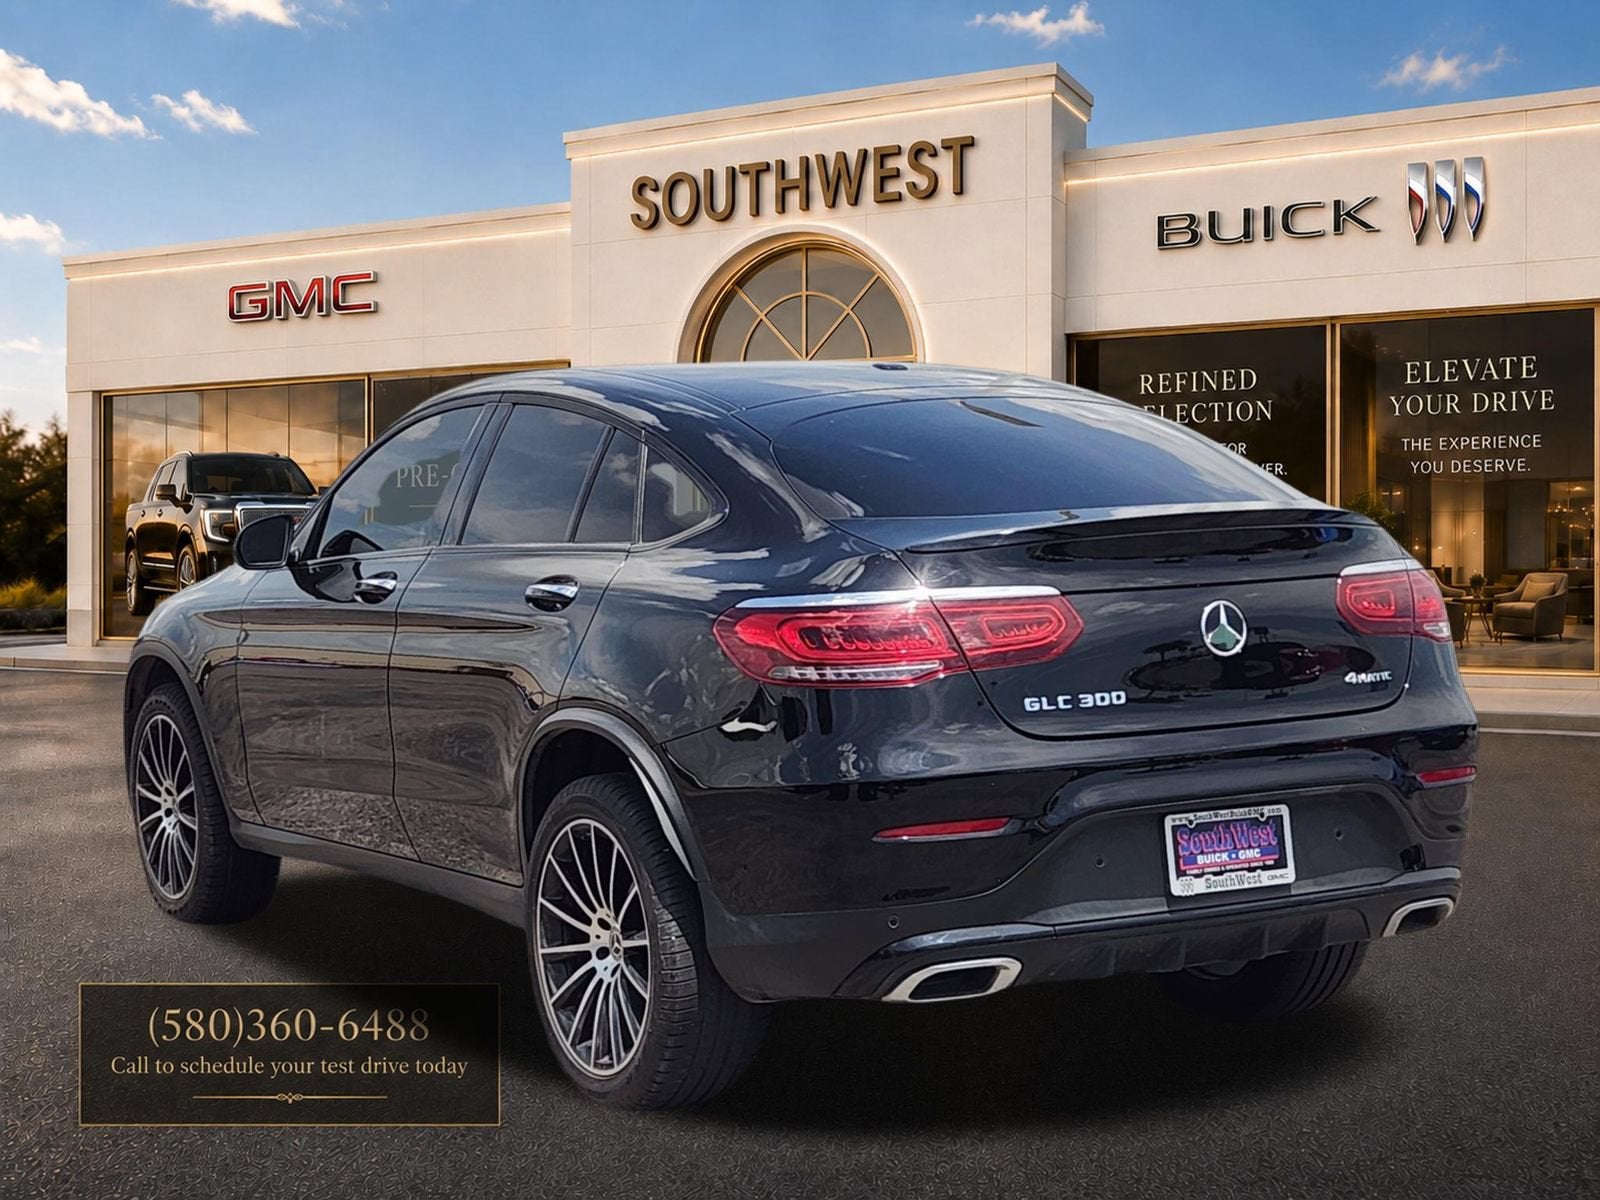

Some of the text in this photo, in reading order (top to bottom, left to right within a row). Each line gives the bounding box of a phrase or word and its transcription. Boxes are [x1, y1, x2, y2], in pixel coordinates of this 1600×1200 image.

[630, 135, 975, 230] SOUTHWEST
[1157, 195, 1381, 250] BUICK
[228, 270, 378, 322] GMC
[1139, 368, 1258, 395] REFINED
[1404, 355, 1538, 385] ELEVATE
[1389, 389, 1555, 416] YOUR DRIVE
[1401, 434, 1542, 451] THE EXPERIENCE
[1410, 458, 1531, 474] YOU DESERVE.
[1023, 690, 1126, 712] GLC 300
[1177, 819, 1278, 856] SouthWest
[1196, 848, 1261, 865] BUICK GMC
[1205, 873, 1263, 889] SouthWest
